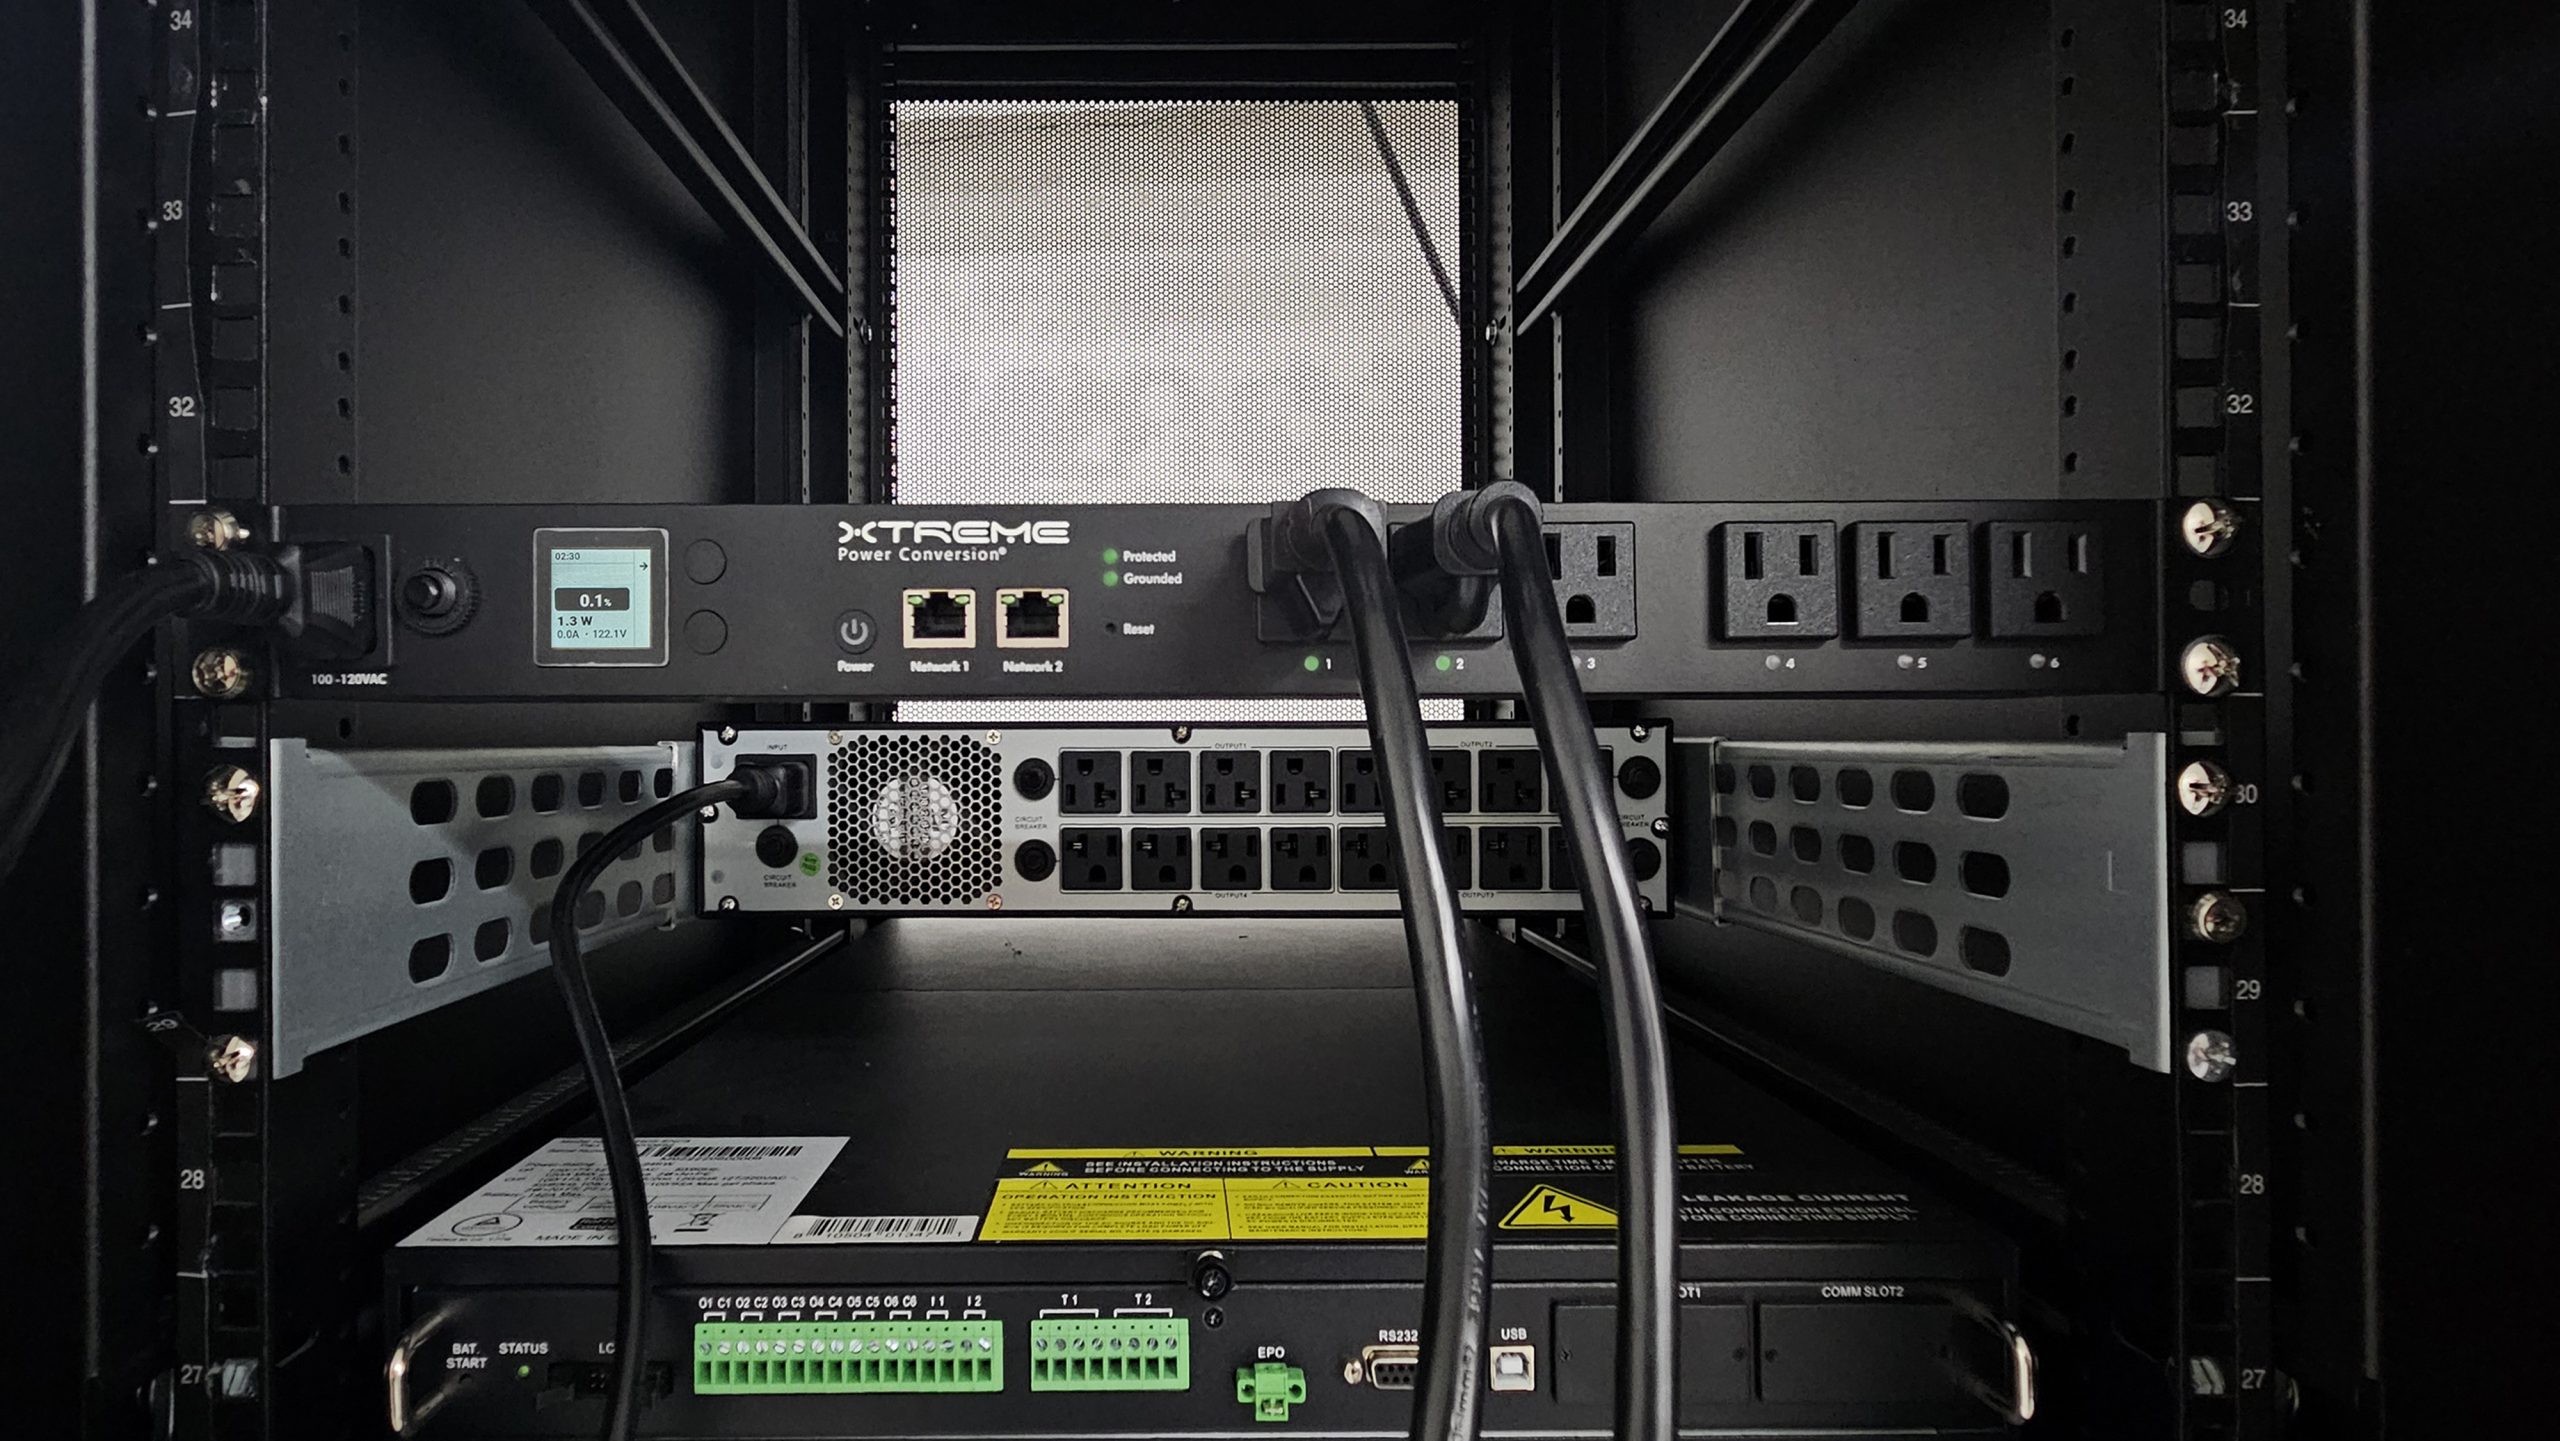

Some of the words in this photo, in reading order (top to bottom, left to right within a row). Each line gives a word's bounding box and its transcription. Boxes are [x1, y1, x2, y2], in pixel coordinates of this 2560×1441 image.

[170, 10, 192, 30] 34
[2224, 8, 2248, 28] 34
[162, 200, 182, 222] 33
[2226, 202, 2252, 222] 33
[170, 396, 196, 418] 32
[2226, 394, 2252, 414] 32
[838, 520, 1070, 544] XTREME
[555, 552, 580, 560] 02:30
[838, 546, 892, 562] Power
[1122, 550, 1176, 562] Protected
[1124, 572, 1182, 584] Grounded
[558, 616, 578, 626] 1.3
[581, 616, 592, 626] W
[557, 630, 580, 639] 0.0A
[593, 630, 627, 638] 122.1V
[1124, 622, 1154, 636] Reset
[838, 660, 874, 672] Power
[910, 660, 960, 672] Network
[962, 660, 970, 672] 1
[1002, 660, 1054, 672] Network
[1054, 660, 1064, 672] 2
[1326, 658, 1332, 670] 1
[1456, 658, 1464, 670] 2
[1586, 658, 1596, 670] 3
[1786, 658, 1796, 668] 4
[1918, 656, 1928, 668] 5
[2050, 658, 2060, 668] 6
[768, 744, 788, 752] INPUT
[2236, 784, 2258, 804] 30
[2236, 980, 2260, 1000] 29
[180, 1168, 204, 1190] 28
[1307, 1181, 1409, 1189] CAUTION
[2240, 1174, 2264, 1194] 28
[1065, 1182, 1192, 1191] ATTENTION
[1680, 1214, 1730, 1222] FORE
[1822, 1286, 1862, 1298] COMM
[1864, 1286, 1904, 1298] SLOT2
[1378, 1330, 1418, 1342] RS232
[1500, 1328, 1528, 1340] USB
[452, 1342, 480, 1354] BAT.
[498, 1342, 548, 1354] STATUS
[598, 1342, 614, 1354] LC
[1258, 1346, 1286, 1358] EPO
[446, 1356, 488, 1368] START
[180, 1364, 204, 1384] 27
[2242, 1368, 2266, 1390] 27
